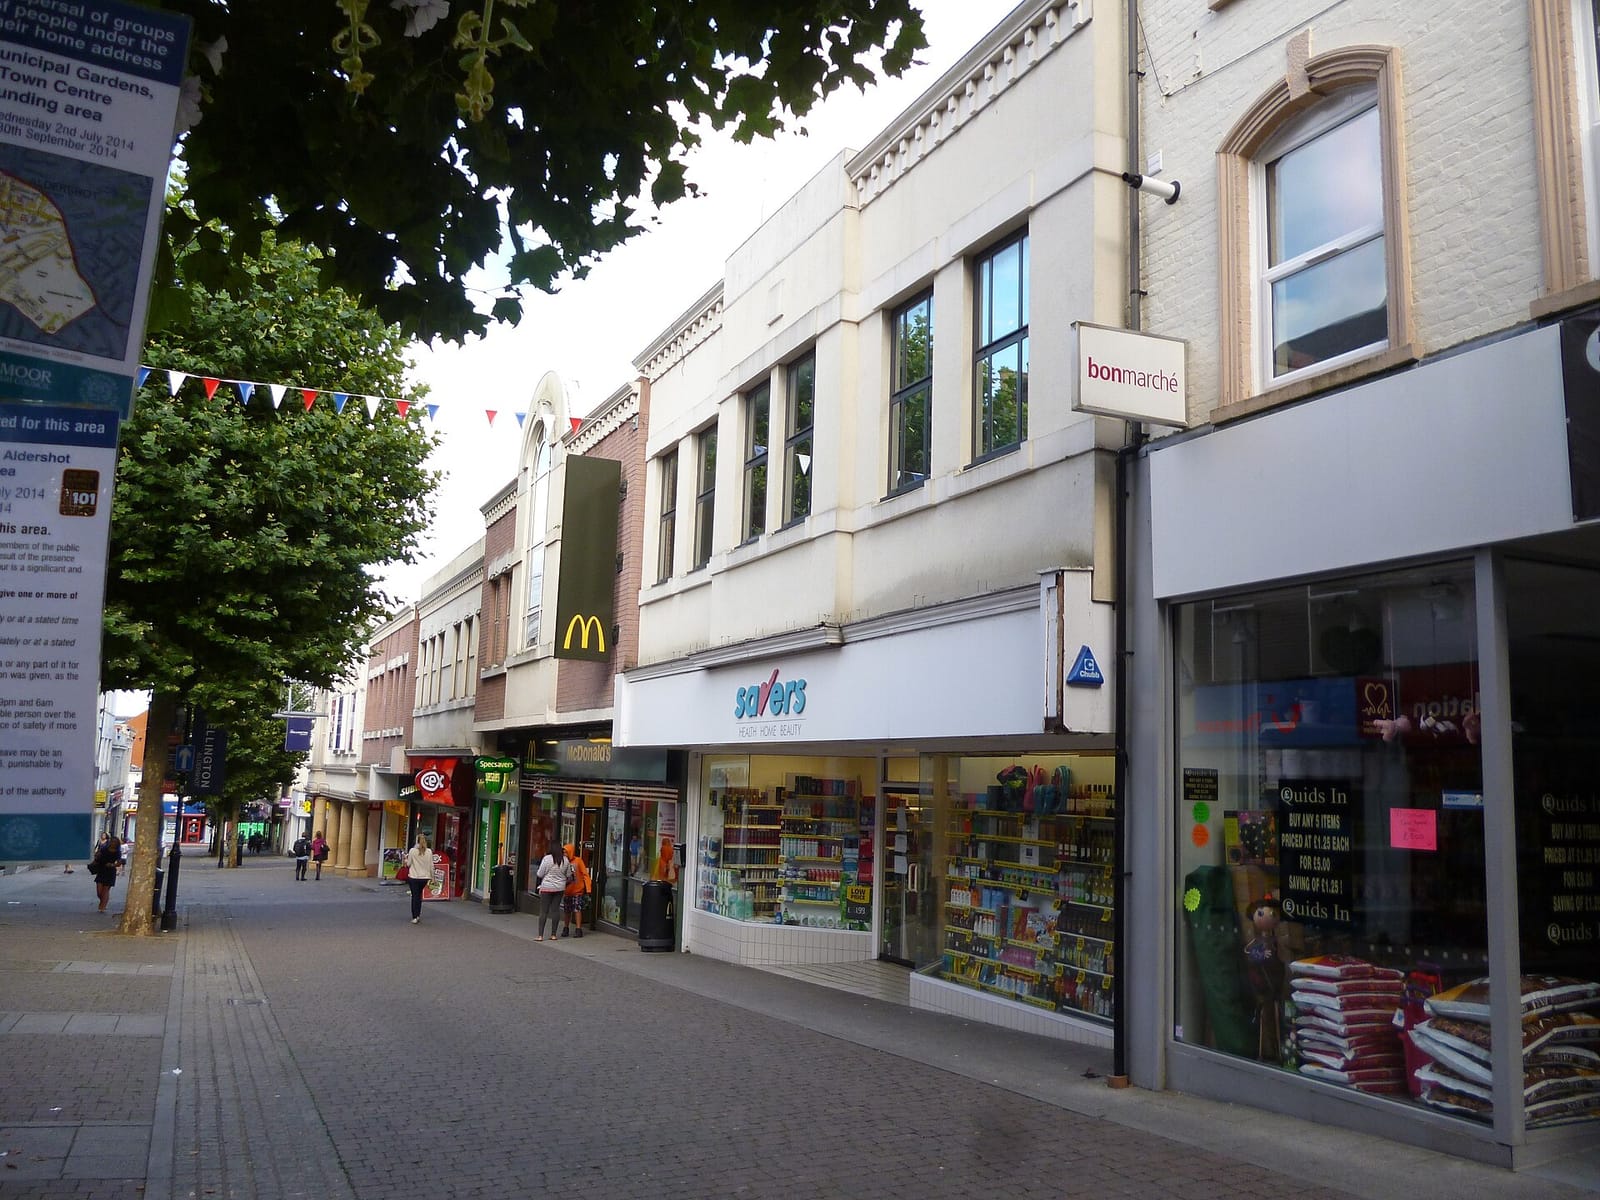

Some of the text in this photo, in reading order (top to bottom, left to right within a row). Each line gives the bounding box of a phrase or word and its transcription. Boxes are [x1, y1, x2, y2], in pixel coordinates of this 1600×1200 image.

[15, 6, 78, 31] people
[84, 25, 136, 46] under
[141, 38, 168, 56] the
[91, 12, 109, 24] of
[114, 18, 175, 42] groups
[35, 25, 85, 49] home
[91, 44, 162, 70] address
[0, 66, 112, 105] Town Centre
[76, 67, 153, 99] Gardens,
[64, 104, 102, 122] area
[26, 128, 85, 151] September
[89, 143, 117, 158] 2014
[56, 122, 76, 137] 2nd
[80, 129, 102, 144] July
[106, 136, 134, 150] 2014
[1088, 356, 1178, 392] bonmarché
[22, 416, 40, 429] for
[45, 418, 70, 431] this
[75, 422, 105, 434] area
[3, 450, 70, 464] Aldershot
[15, 488, 45, 499] 2014
[72, 492, 96, 505] 101
[21, 525, 51, 535] area.
[32, 542, 40, 550] of
[56, 544, 80, 552] public
[28, 553, 39, 561] the
[27, 565, 66, 573] significant
[17, 615, 25, 623] at
[35, 616, 60, 624] stated
[51, 638, 76, 646] stated
[16, 661, 30, 669] any
[33, 661, 48, 669] part
[51, 660, 59, 668] of
[61, 661, 66, 669] it
[69, 661, 79, 669] for
[67, 672, 79, 680] the
[1079, 670, 1100, 678] Chubb
[734, 668, 807, 719] savers
[36, 698, 53, 707] 6am
[14, 711, 41, 719] person
[23, 722, 46, 730] safety
[49, 721, 54, 729] if
[760, 725, 776, 736] HOME
[780, 724, 801, 736] BEAUTY
[201, 723, 216, 788] ELLINGTON
[566, 744, 611, 762] McDonald's
[8, 760, 50, 768] punishable
[54, 761, 63, 769] by
[480, 760, 513, 769] Specsavers
[6, 787, 14, 795] of
[32, 788, 65, 796] authority
[1280, 787, 1347, 806] Quids In
[1542, 792, 1586, 816] Quids
[1289, 813, 1340, 829] BUY ANY 5 ITEMS
[1552, 824, 1564, 840] BUY
[1564, 824, 1576, 840] ANY
[1281, 833, 1350, 851] PRICED AT £1.25 EACH
[1299, 856, 1331, 871] FOR £5.00
[1544, 848, 1567, 864] PRICED
[1289, 875, 1310, 891] SAVING
[1312, 877, 1320, 892] OF
[1563, 872, 1576, 888] FOR
[1282, 898, 1351, 921] Quids In
[1553, 896, 1574, 912] SAVING
[1548, 923, 1592, 945] Quids
